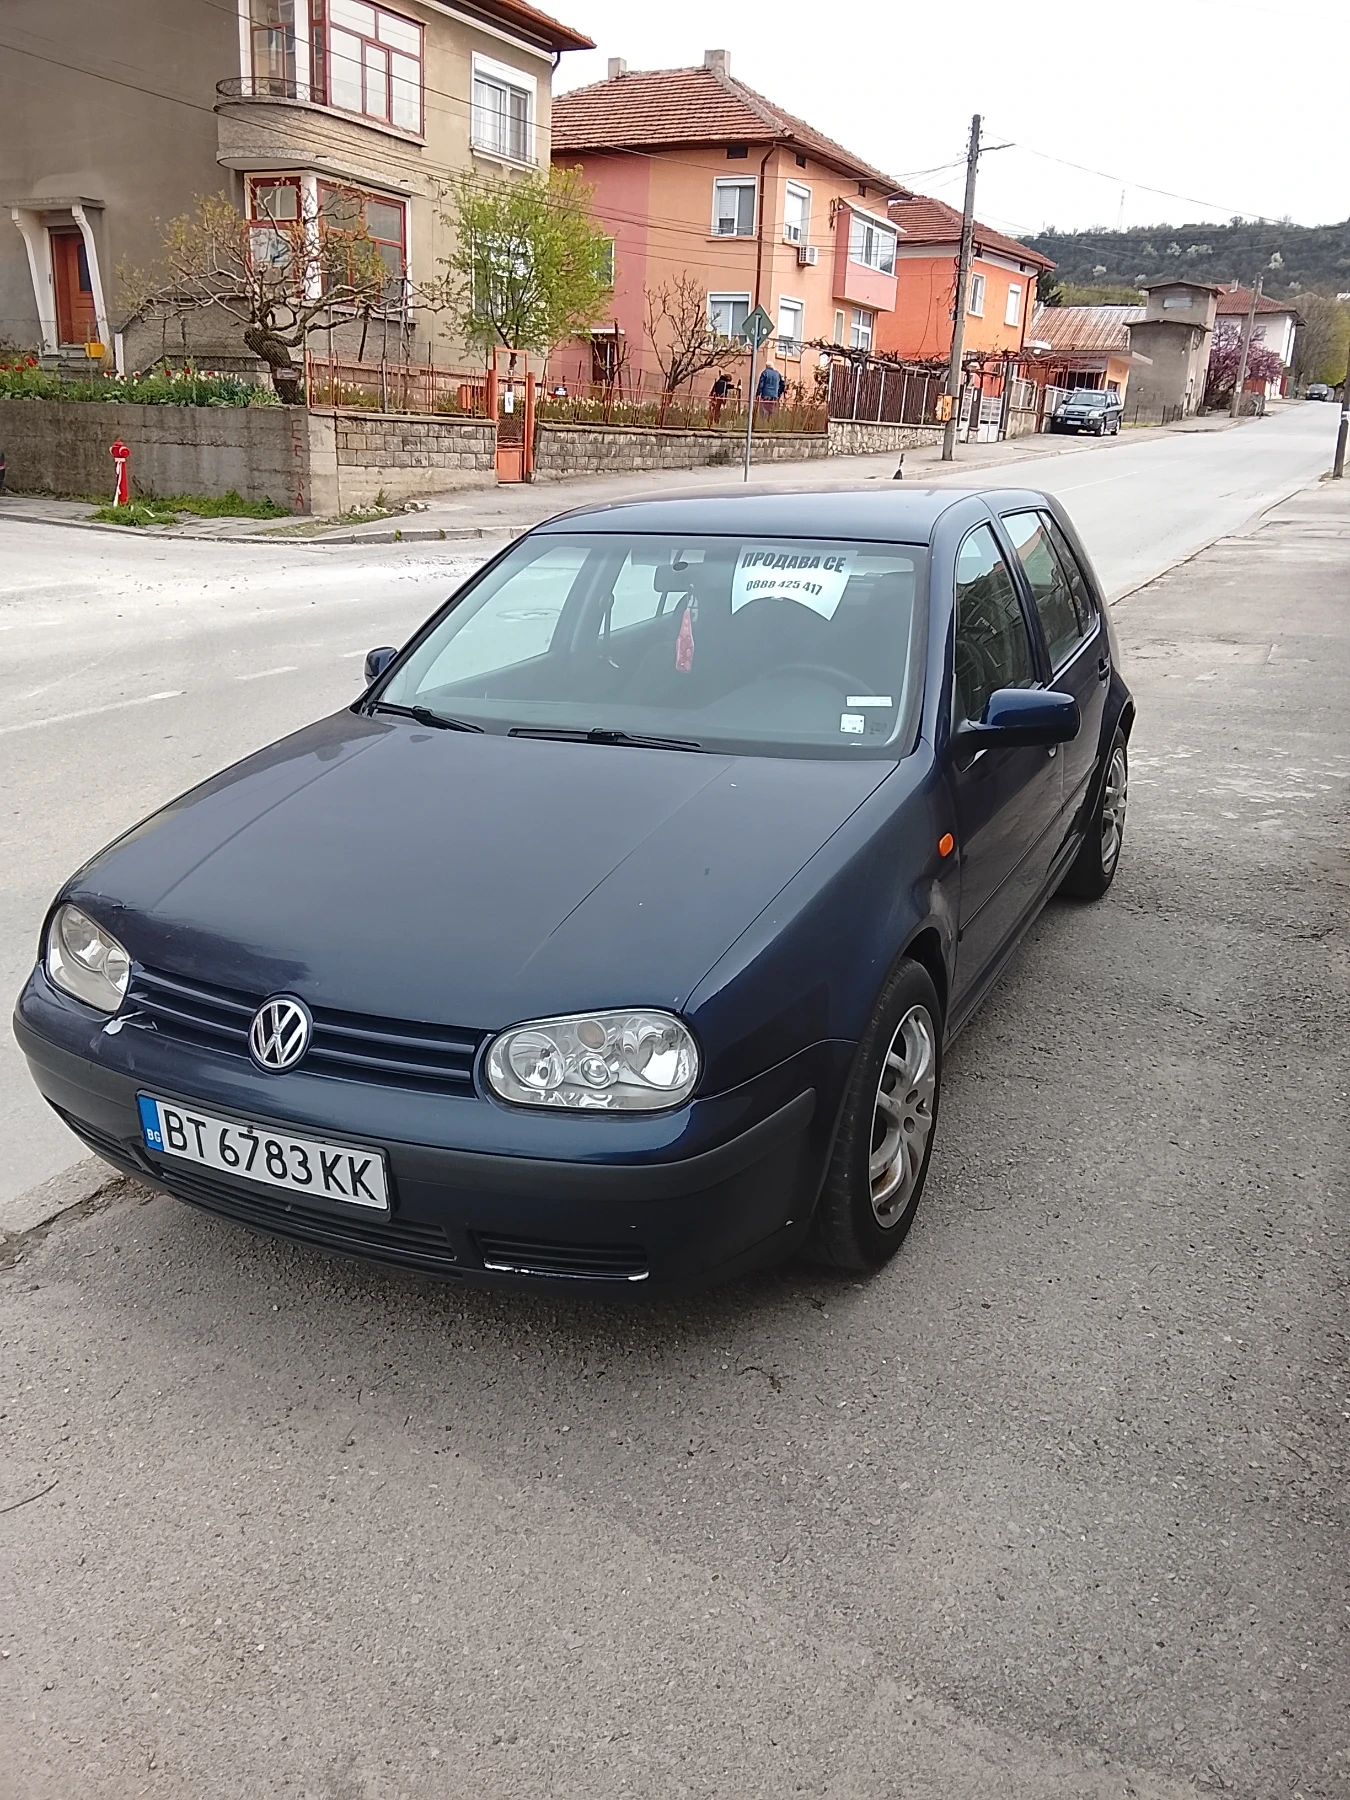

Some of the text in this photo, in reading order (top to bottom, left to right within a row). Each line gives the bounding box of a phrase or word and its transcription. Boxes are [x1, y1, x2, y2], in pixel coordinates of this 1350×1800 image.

[741, 552, 846, 573] ПРОДАВА СЕ
[746, 580, 823, 596] 0888 425 417
[251, 1000, 307, 1068] VW
[146, 1127, 161, 1142] BG
[163, 1109, 378, 1201] BT 6783 KK
